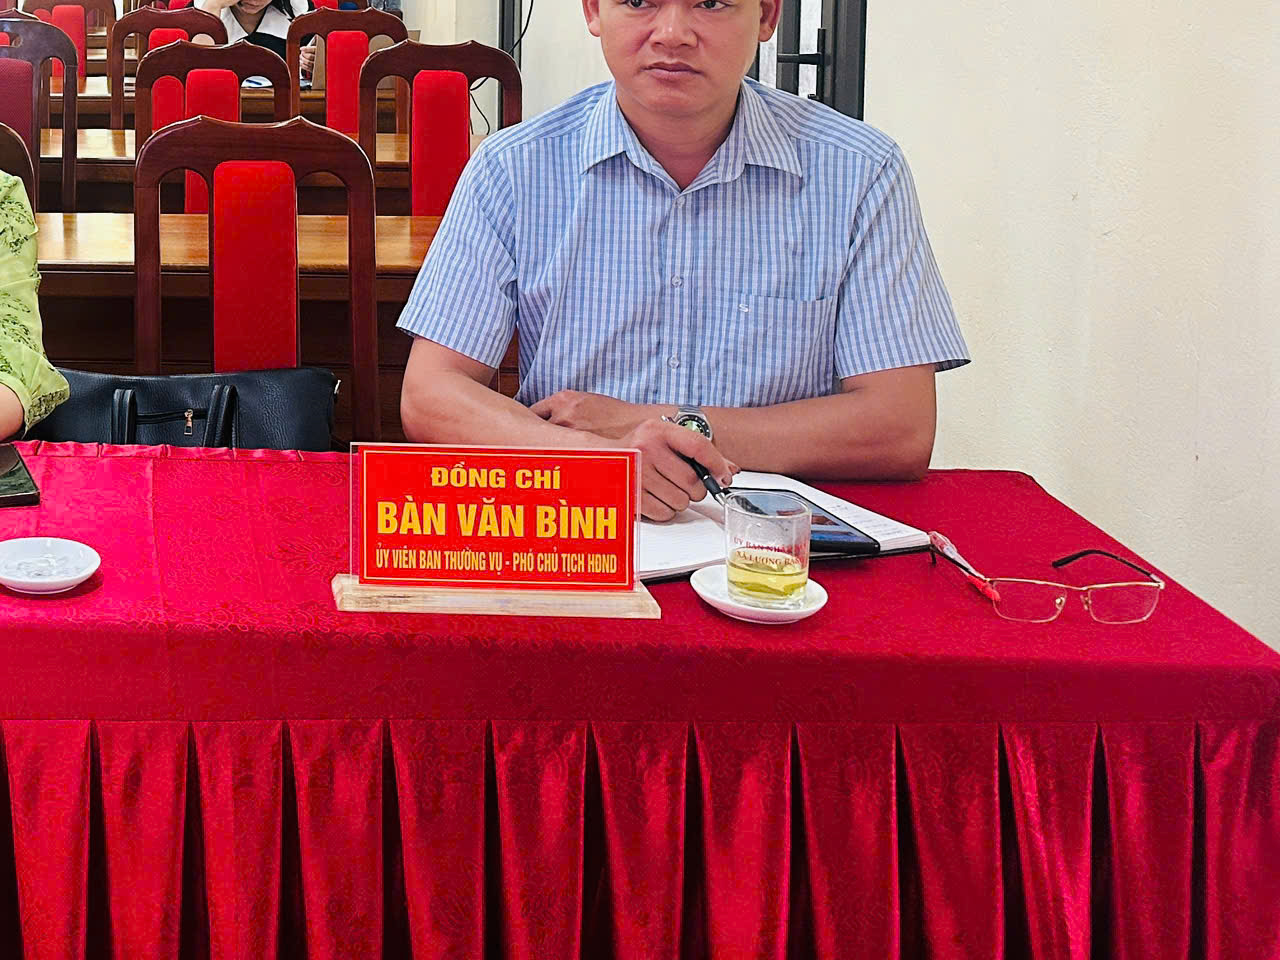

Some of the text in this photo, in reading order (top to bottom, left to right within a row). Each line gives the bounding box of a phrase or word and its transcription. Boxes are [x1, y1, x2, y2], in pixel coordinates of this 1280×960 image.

[430, 461, 561, 490] ĐỒNG CHÍ
[376, 495, 618, 540] BÀN VĂN BÌNH
[376, 542, 390, 569] ỦY
[392, 545, 417, 569] VIÊN
[419, 550, 441, 570] BAN
[443, 546, 486, 572] THƯỜNG
[488, 551, 503, 576] VỤ
[512, 548, 535, 572] PHÓ
[536, 545, 559, 573] CHỦ
[560, 552, 585, 577] TỊCH
